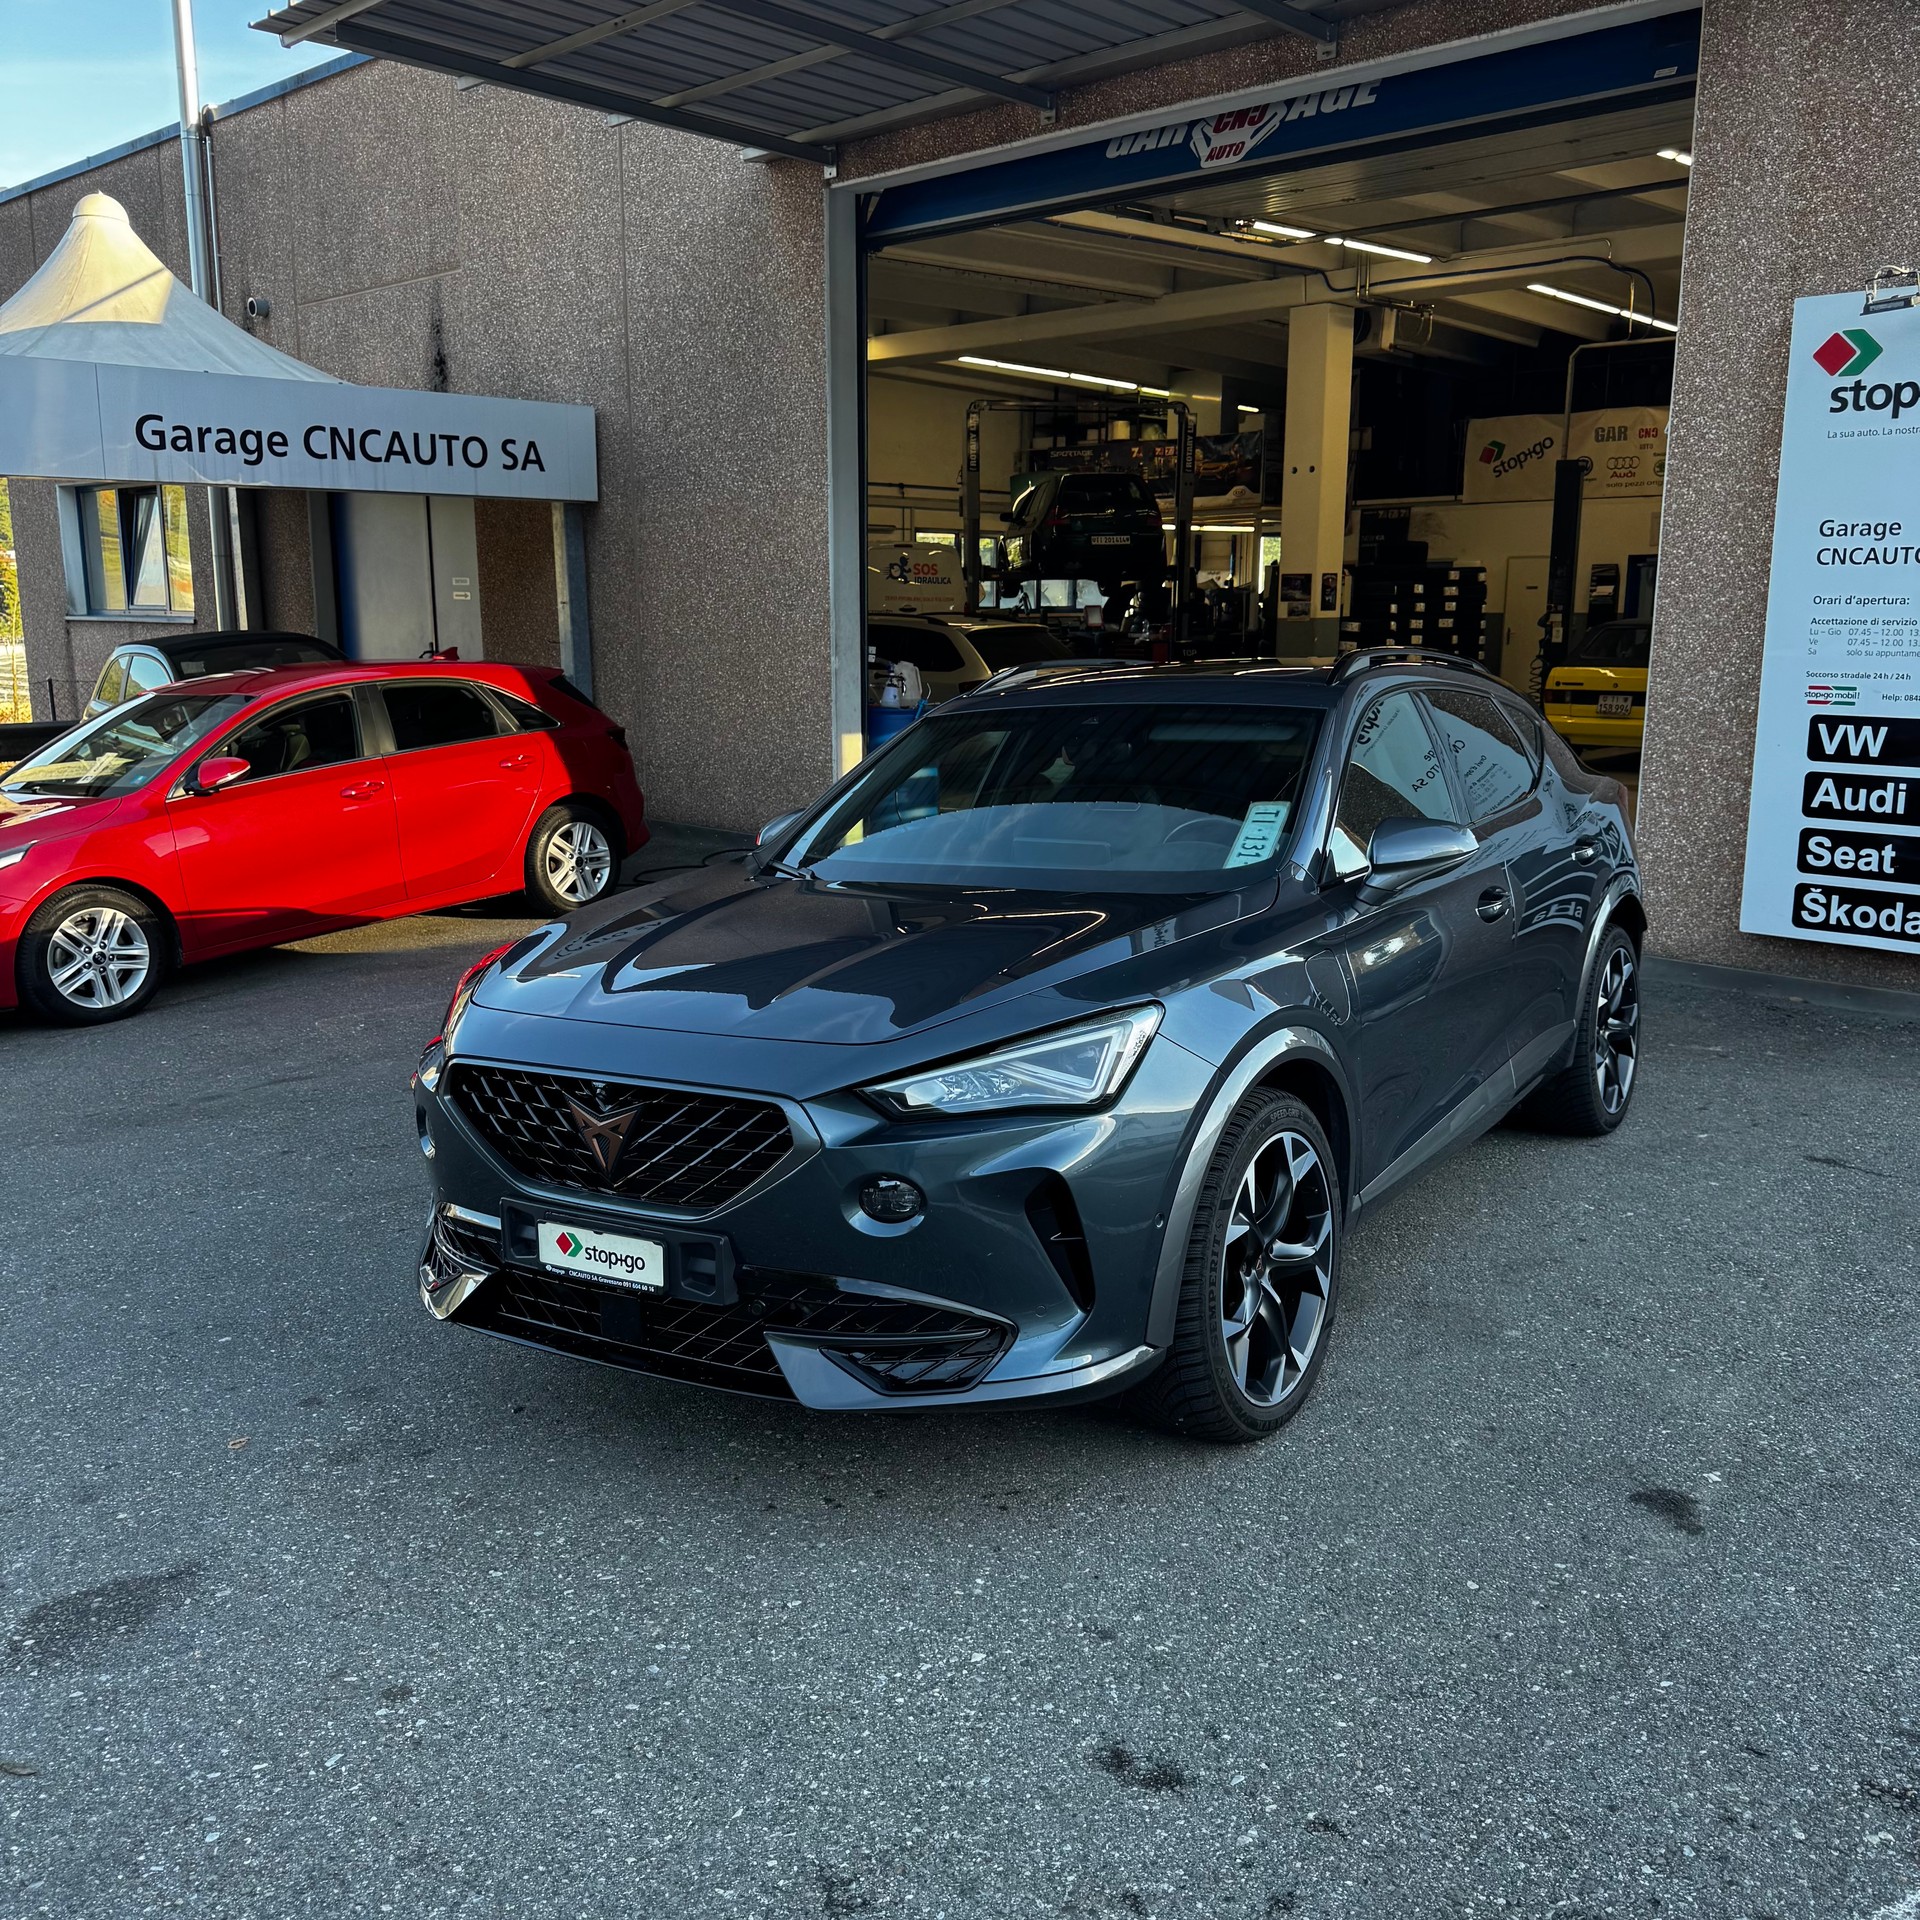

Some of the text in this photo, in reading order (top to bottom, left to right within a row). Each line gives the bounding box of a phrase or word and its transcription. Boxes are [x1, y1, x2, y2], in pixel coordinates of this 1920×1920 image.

[1205, 141, 1246, 162] AUTO
[1594, 425, 1628, 443] GAR
[1827, 425, 1920, 439] La sua auto. La nostr
[135, 414, 546, 472] Garage CNCAUTO SA
[969, 433, 978, 467] ROTARY
[1050, 449, 1094, 459] SPORTAGE
[1185, 435, 1195, 469] ROTARY
[1493, 436, 1555, 478] stop+go
[1610, 470, 1636, 479] Audi
[1819, 518, 1902, 541] Garage
[913, 562, 939, 576] SOS
[914, 576, 952, 585] IDRAULICA
[1813, 595, 1842, 605] Orari
[1810, 617, 1918, 627] Accettazione di servizio
[1809, 628, 1819, 636] Lu
[1828, 628, 1842, 636] Gio
[1848, 628, 1872, 636] 07.45
[1881, 628, 1904, 637] 12.00
[1847, 638, 1871, 646] 07.45
[1880, 638, 1904, 647] 12.00
[1808, 647, 1817, 656] Sa
[1846, 648, 1863, 657] solo
[1806, 670, 1839, 678] Soccorso
[1840, 671, 1872, 679] stradale
[1834, 691, 1861, 700] mobil!
[1882, 693, 1903, 702] Help:
[1818, 723, 1889, 758] VW
[1810, 778, 1907, 815] Audi
[1806, 836, 1896, 874] Seat
[1800, 887, 1920, 935] Škoda
[585, 1245, 646, 1274] stop+go
[1208, 1234, 1221, 1349] SEMPERIT
